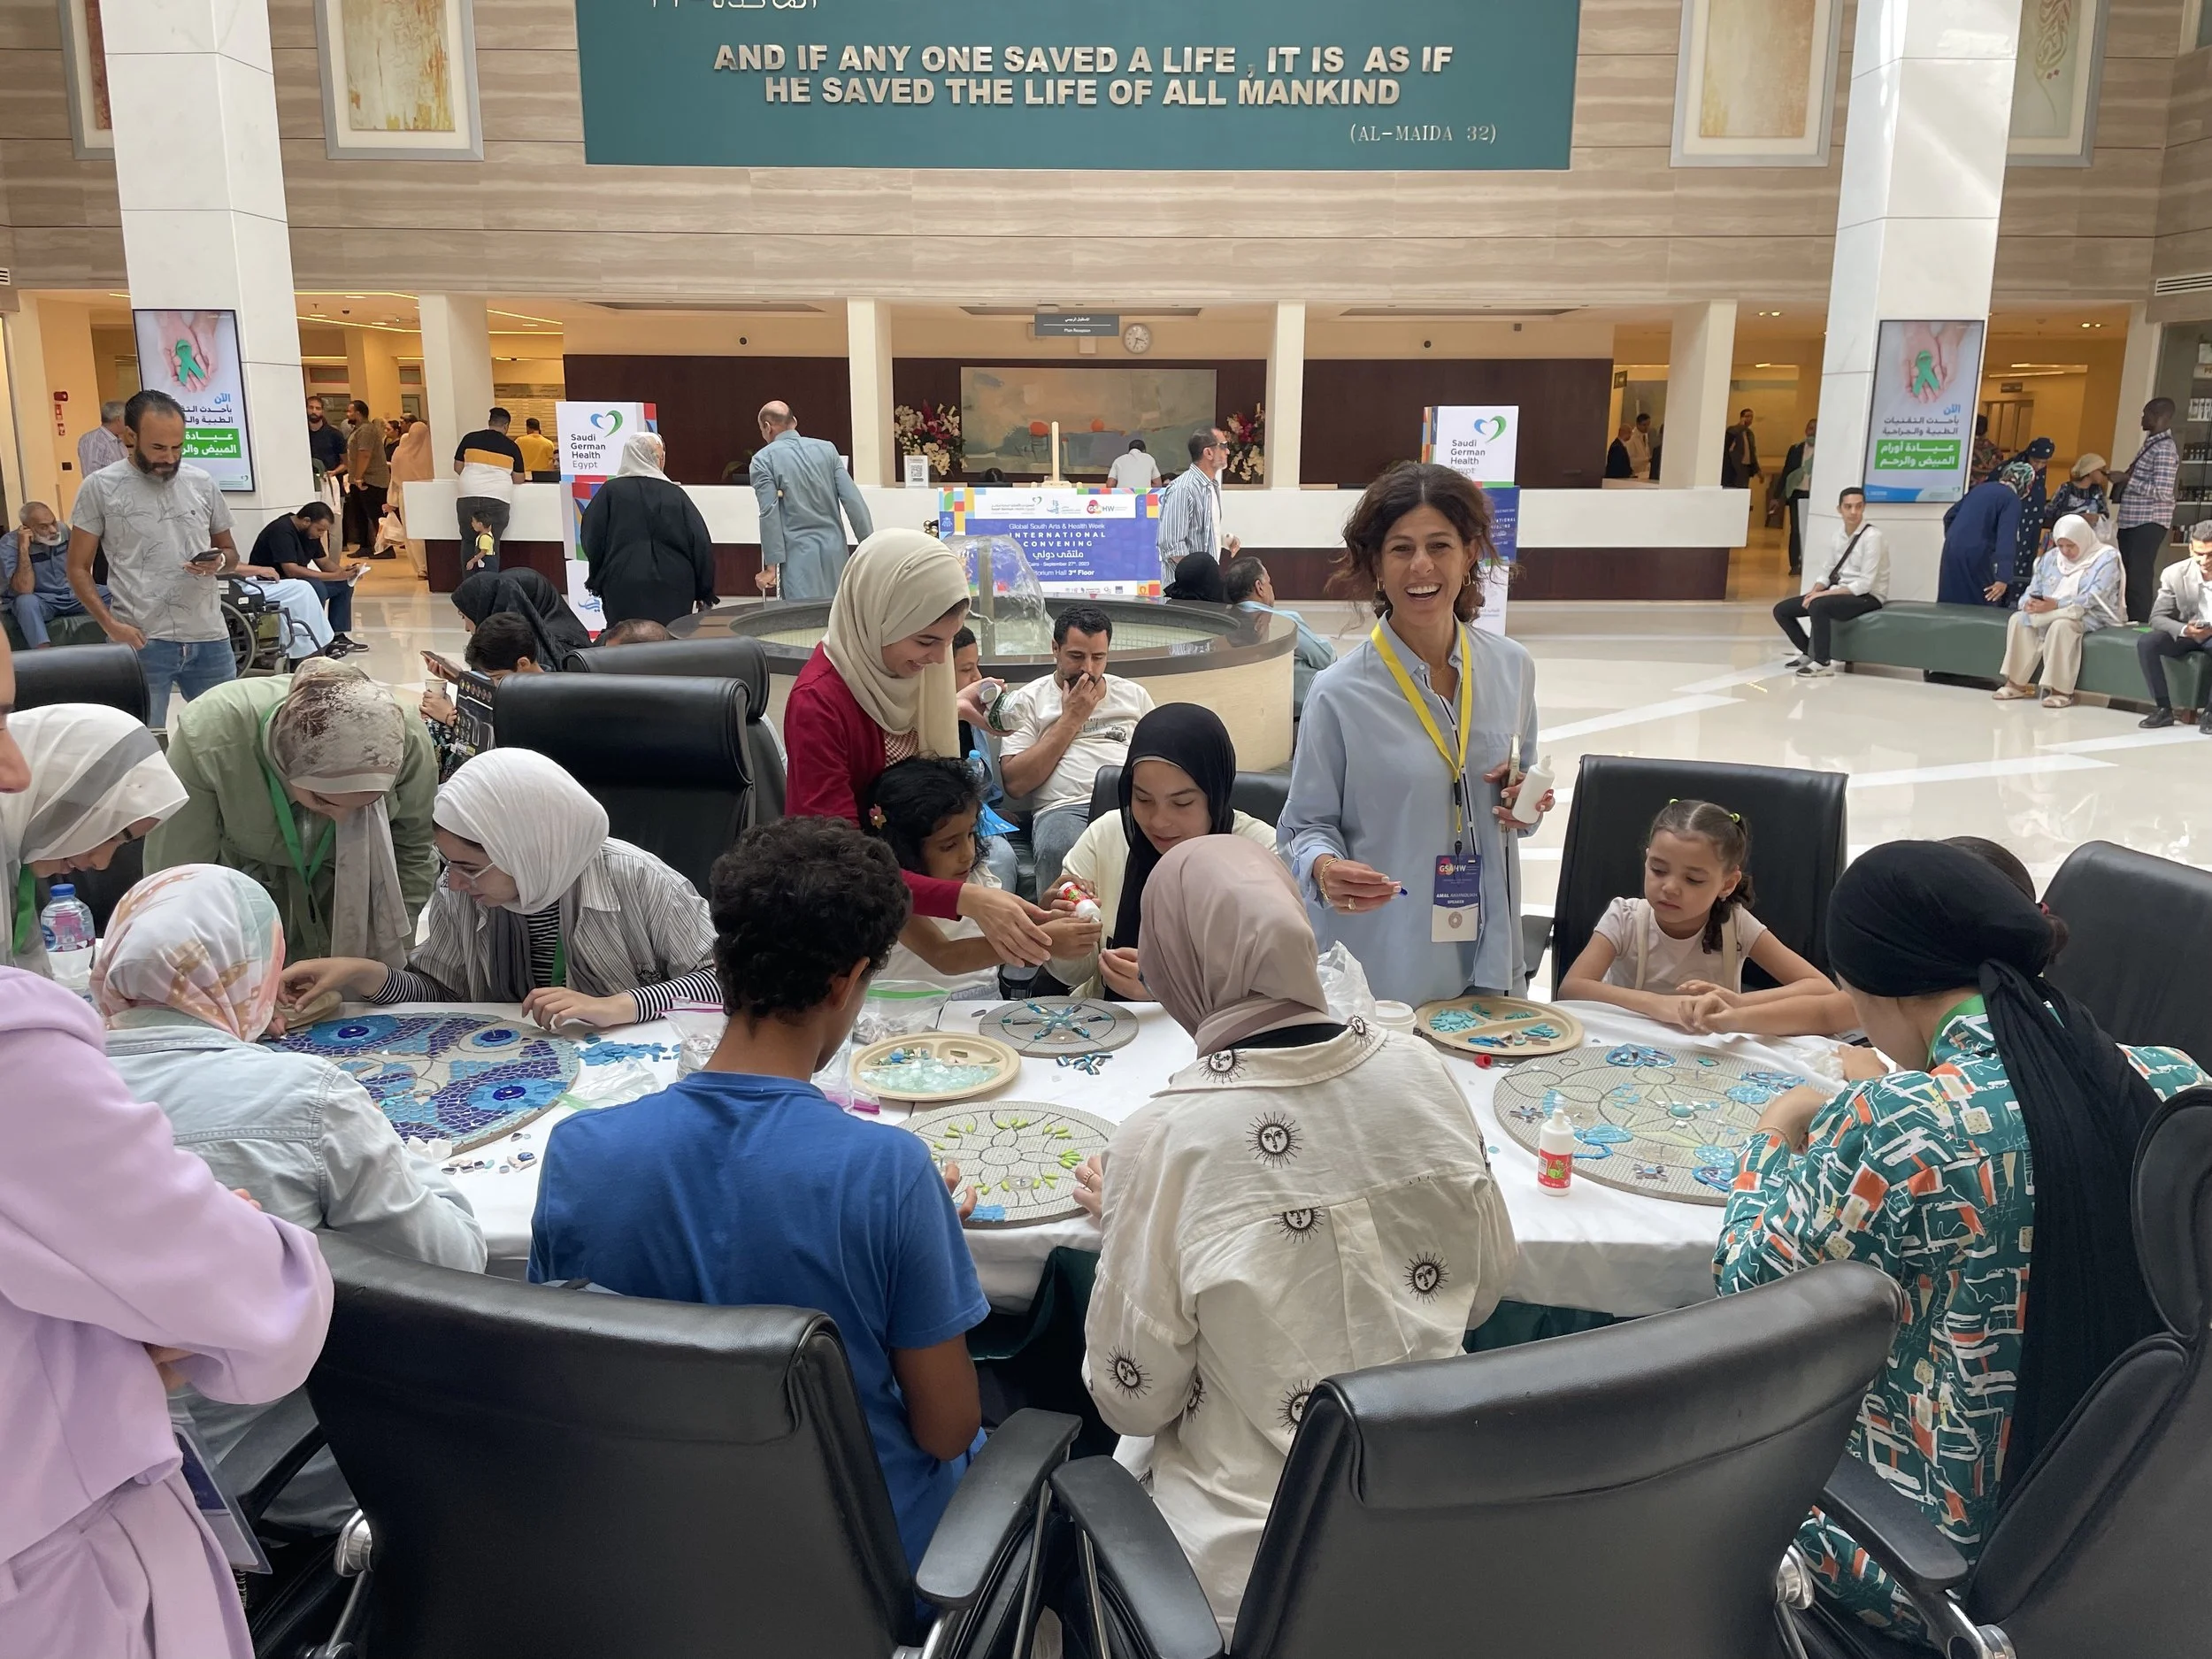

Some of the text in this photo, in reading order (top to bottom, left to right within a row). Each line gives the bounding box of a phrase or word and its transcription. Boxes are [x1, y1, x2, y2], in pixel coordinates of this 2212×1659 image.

[713, 44, 786, 71] AND
[797, 44, 828, 71] IF
[838, 45, 911, 72] ANY
[921, 46, 994, 72] ONE
[1003, 46, 1118, 73] SAVED
[1127, 46, 1153, 73] A
[1163, 46, 1236, 73] LIFE
[1267, 46, 1302, 73] IT
[1311, 46, 1345, 73] IS
[1363, 46, 1410, 73] AS
[1422, 46, 1453, 73] IF
[765, 77, 1400, 105] HE SAVED THE LIFE OF ALL MANKIND
[1350, 123, 1496, 145] (AL-MAIDA 32)
[214, 393, 231, 404] الآن
[1943, 403, 1961, 415] الآن
[202, 416, 234, 425] الطبية
[1925, 426, 1958, 435] الطبية
[181, 444, 237, 456] المبيض والر
[1880, 441, 1903, 454] أورام
[572, 460, 598, 470] Egypt
[1879, 456, 1955, 468] المبيض والرحم
[1033, 549, 1084, 560] ملتقى دولي
